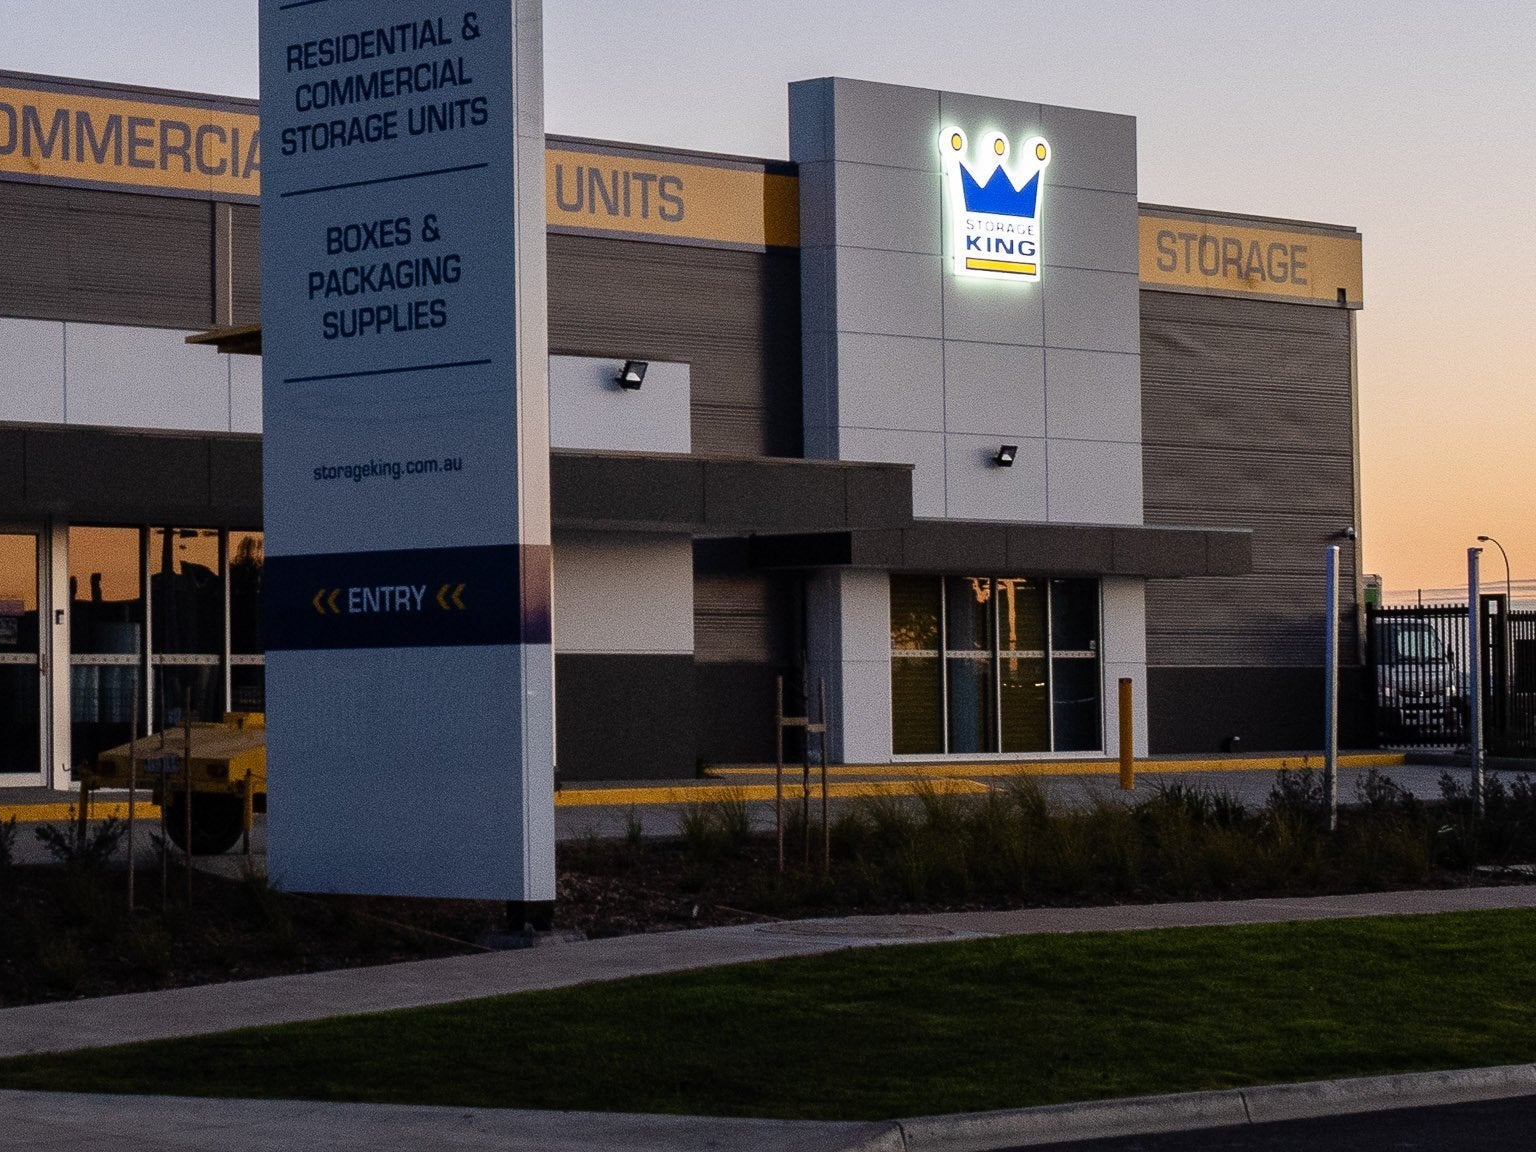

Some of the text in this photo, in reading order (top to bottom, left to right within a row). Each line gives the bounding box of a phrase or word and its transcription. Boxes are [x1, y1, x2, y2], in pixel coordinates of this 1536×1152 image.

[286, 11, 481, 73] RESIDENTIAL &
[295, 57, 473, 112] COMMERCIAL
[281, 97, 489, 156] STORAGE UNITS
[555, 164, 685, 222] UNITS
[326, 214, 441, 255] BOXES &
[966, 219, 1035, 236] STORAGE
[966, 235, 1036, 256] KING
[308, 254, 462, 299] PACKAGING
[1156, 229, 1308, 285] STORAGE
[322, 299, 447, 340] SUPPLIES
[313, 457, 463, 482] storageking.com.au
[348, 584, 427, 614] ENTRY
